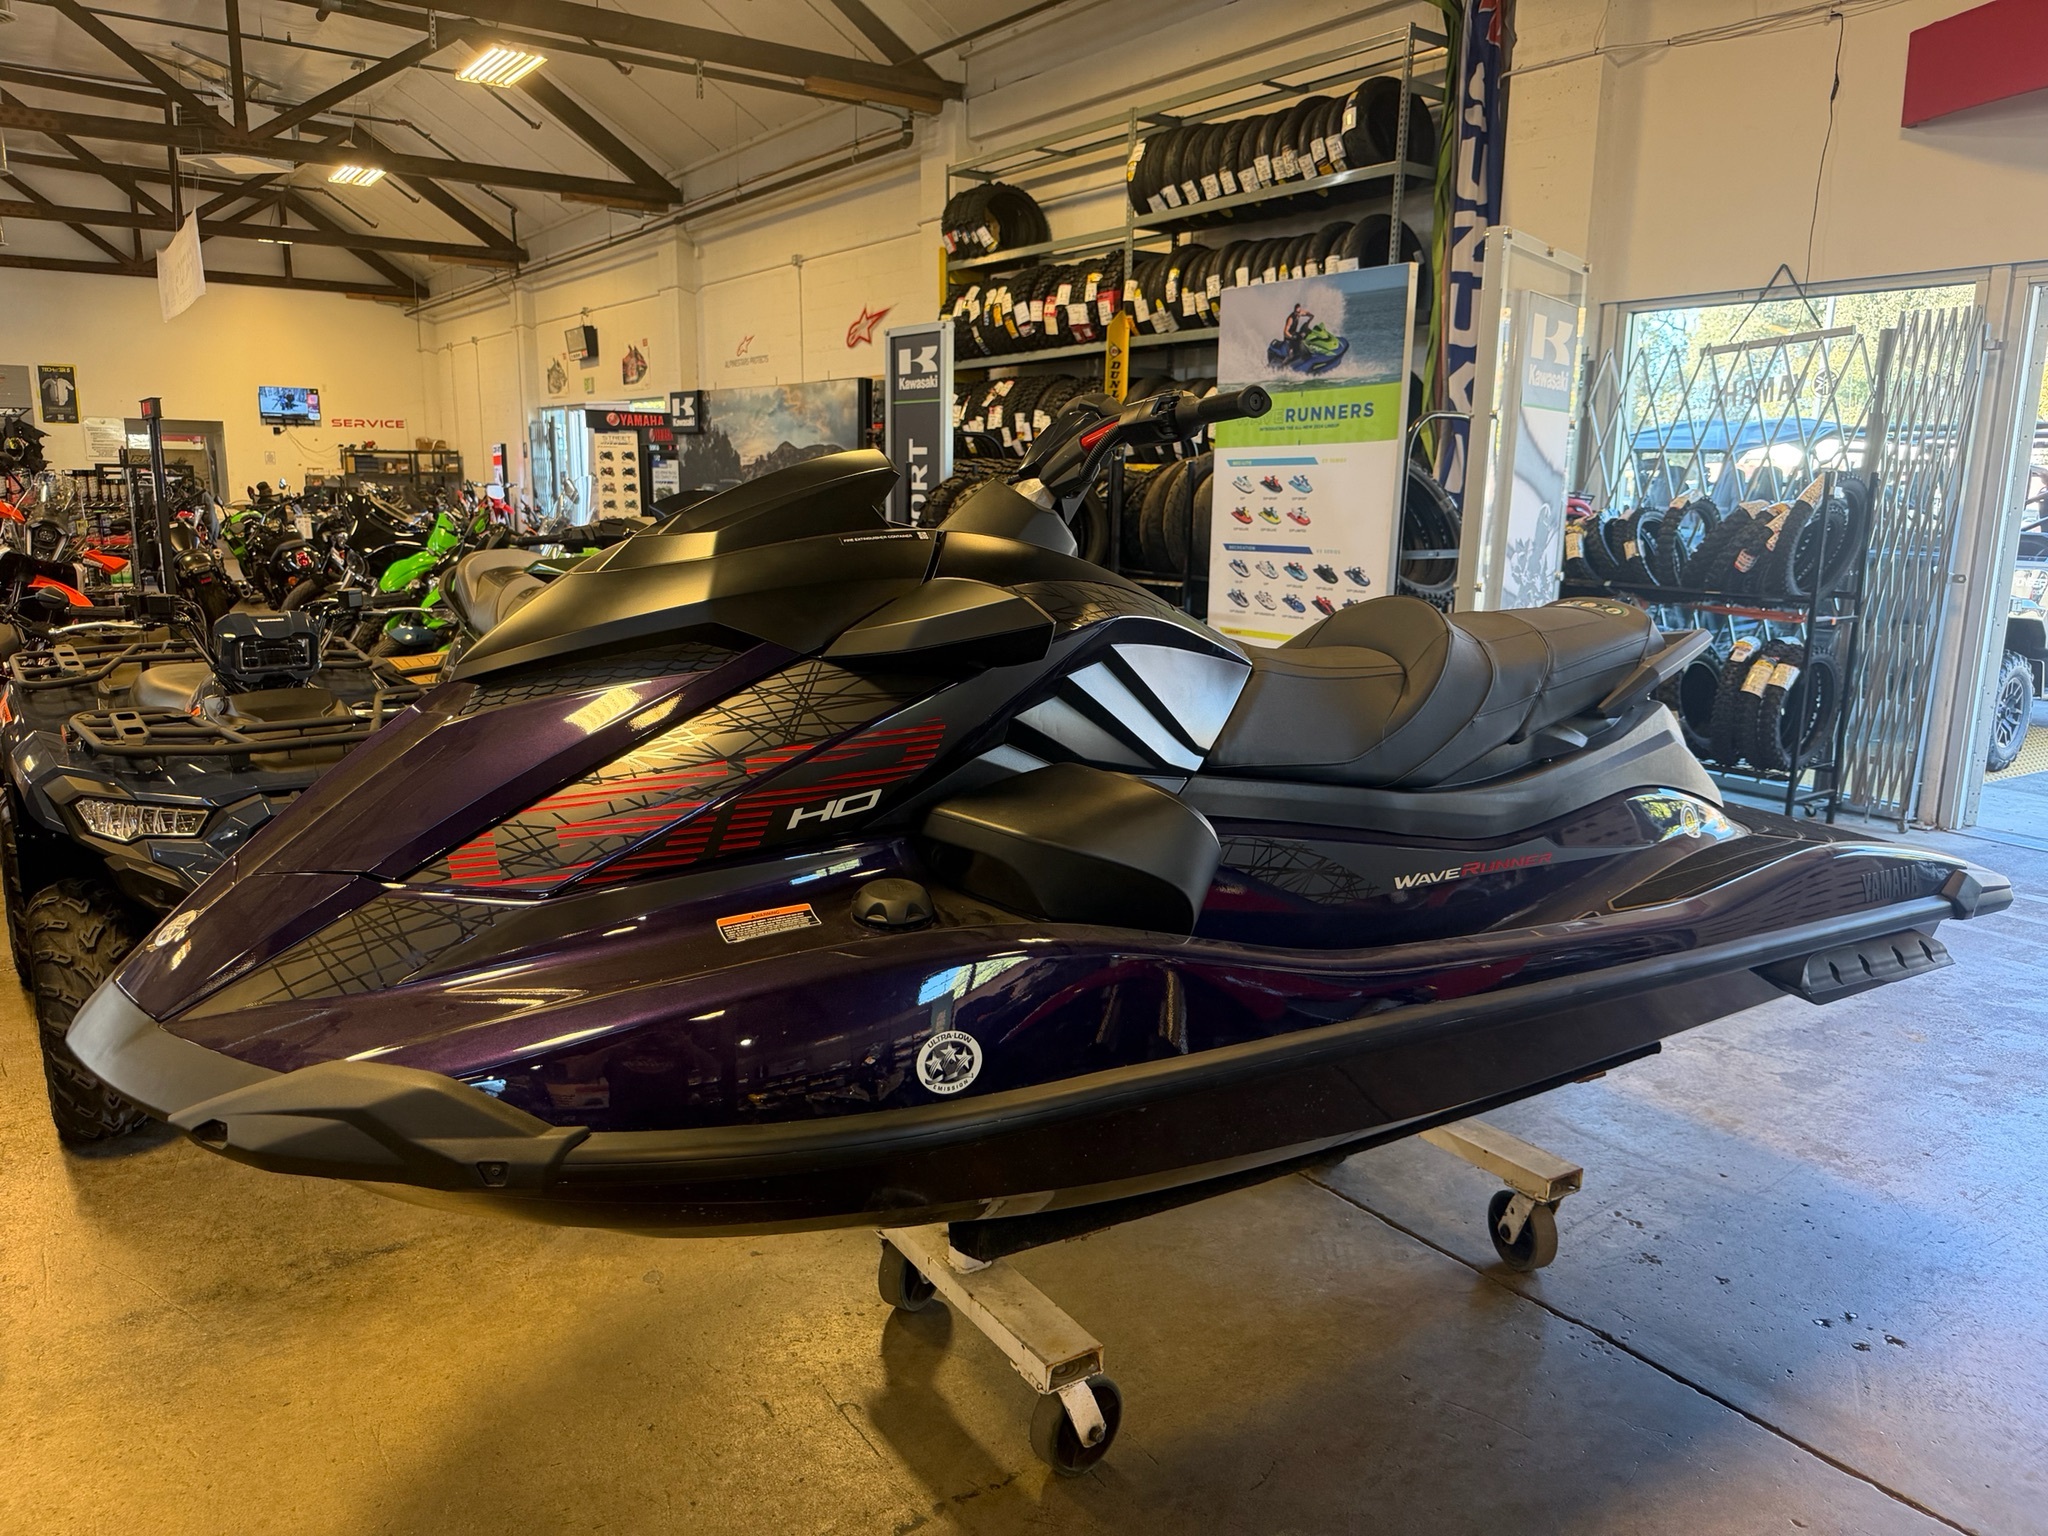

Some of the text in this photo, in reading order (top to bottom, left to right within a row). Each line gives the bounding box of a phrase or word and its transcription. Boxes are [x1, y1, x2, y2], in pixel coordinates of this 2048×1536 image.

[898, 375, 939, 391] Kawasaki
[1528, 363, 1569, 392] Kawasaki
[331, 418, 405, 429] SERVICE
[619, 413, 665, 427] YAMAHA
[1861, 864, 1919, 903] YAMAHA
[932, 1079, 969, 1092] EMISSION
